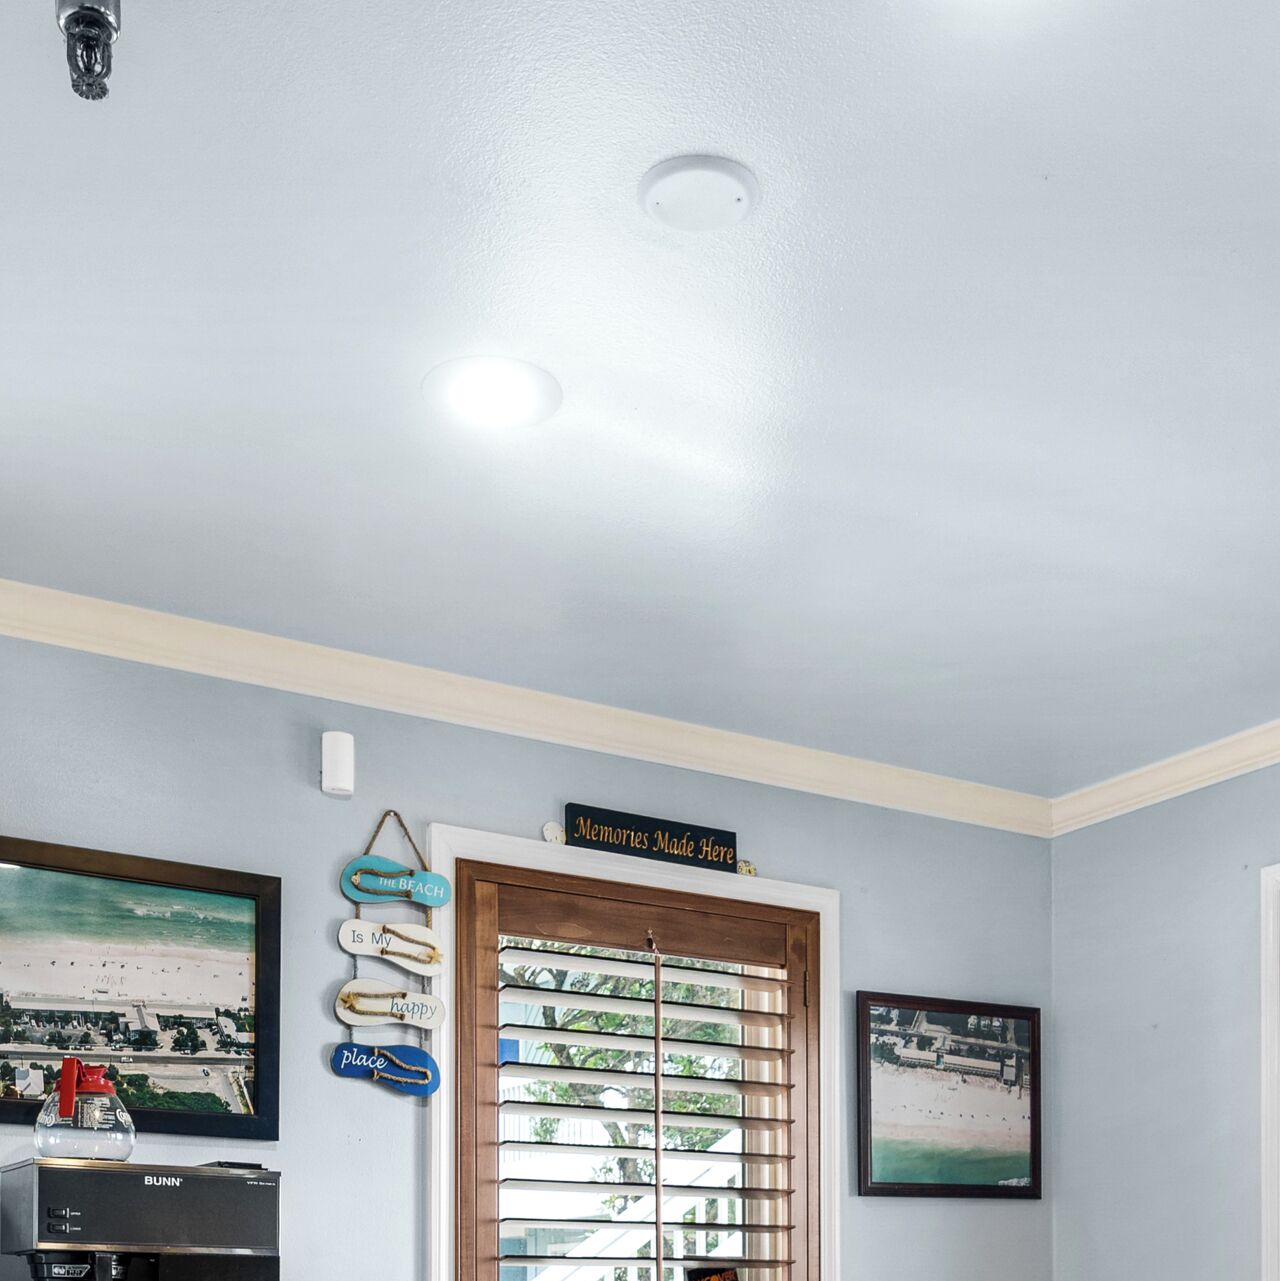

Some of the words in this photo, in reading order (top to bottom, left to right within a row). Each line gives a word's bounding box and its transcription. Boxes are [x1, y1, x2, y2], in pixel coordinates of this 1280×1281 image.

[573, 816, 648, 849] Memories
[653, 830, 695, 857] Made
[698, 836, 734, 864] Here
[379, 877, 397, 888] THE
[399, 879, 444, 898] BEACH
[352, 930, 363, 943] Is
[371, 931, 392, 948] My
[390, 996, 437, 1020] happy
[341, 1049, 388, 1069] place
[144, 1176, 181, 1187] BUNN
